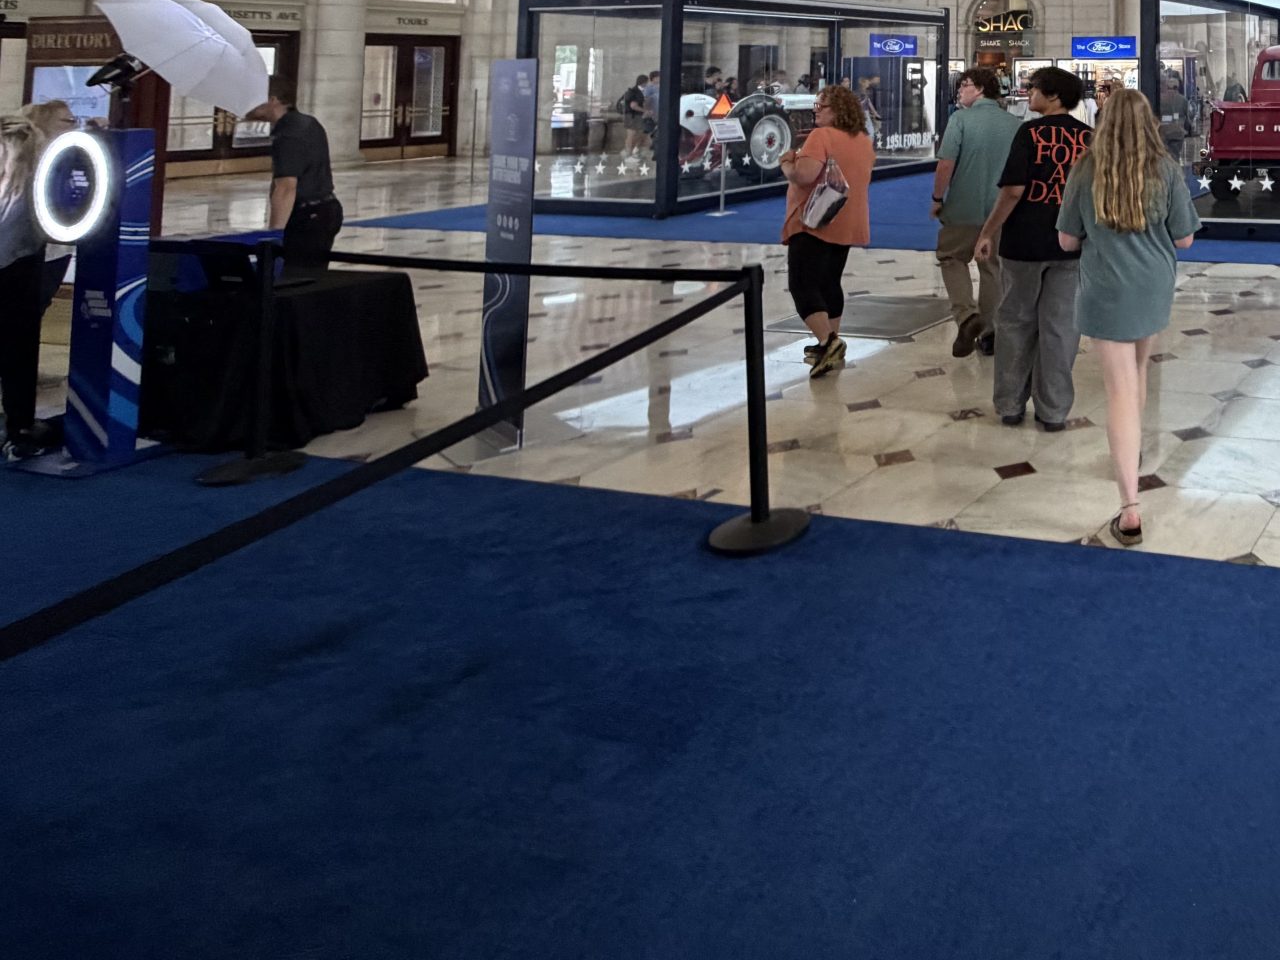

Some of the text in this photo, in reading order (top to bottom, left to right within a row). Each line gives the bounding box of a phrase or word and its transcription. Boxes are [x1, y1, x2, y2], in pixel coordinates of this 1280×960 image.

[397, 17, 429, 26] TOURS
[31, 33, 112, 49] DIRECTORY
[980, 39, 1030, 47] SHAKE SHACK
[903, 132, 922, 149] FORD
[1047, 164, 1066, 184] A
[1027, 179, 1062, 205] DA
